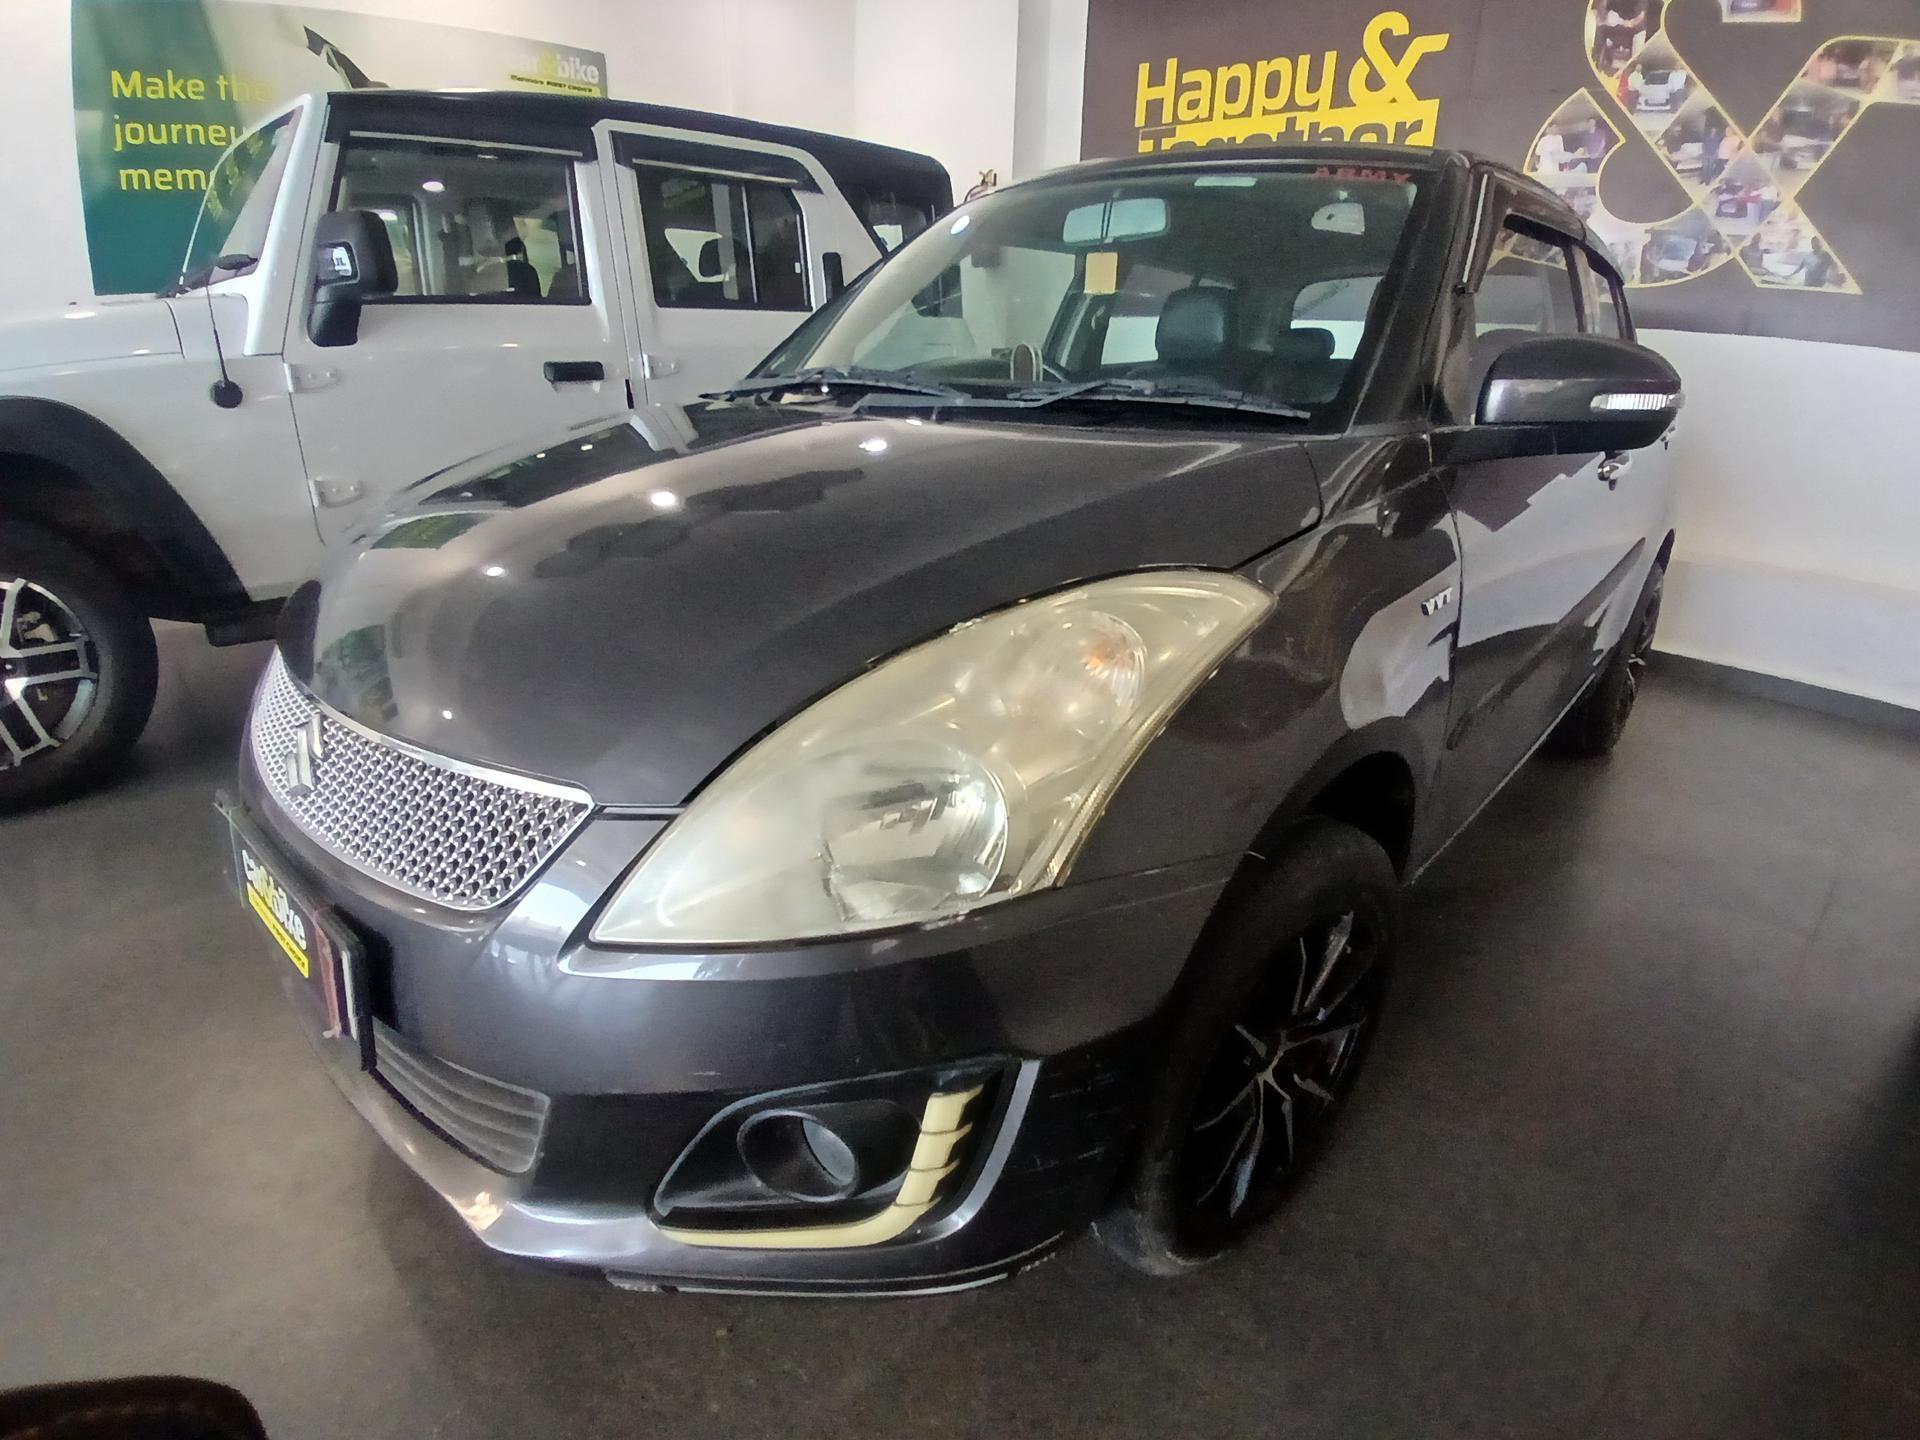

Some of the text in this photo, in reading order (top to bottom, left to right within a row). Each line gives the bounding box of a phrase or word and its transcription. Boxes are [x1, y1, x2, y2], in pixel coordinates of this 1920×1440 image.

[111, 69, 273, 102] Make the
[1135, 11, 1450, 129] Happy &
[119, 168, 216, 191] mem
